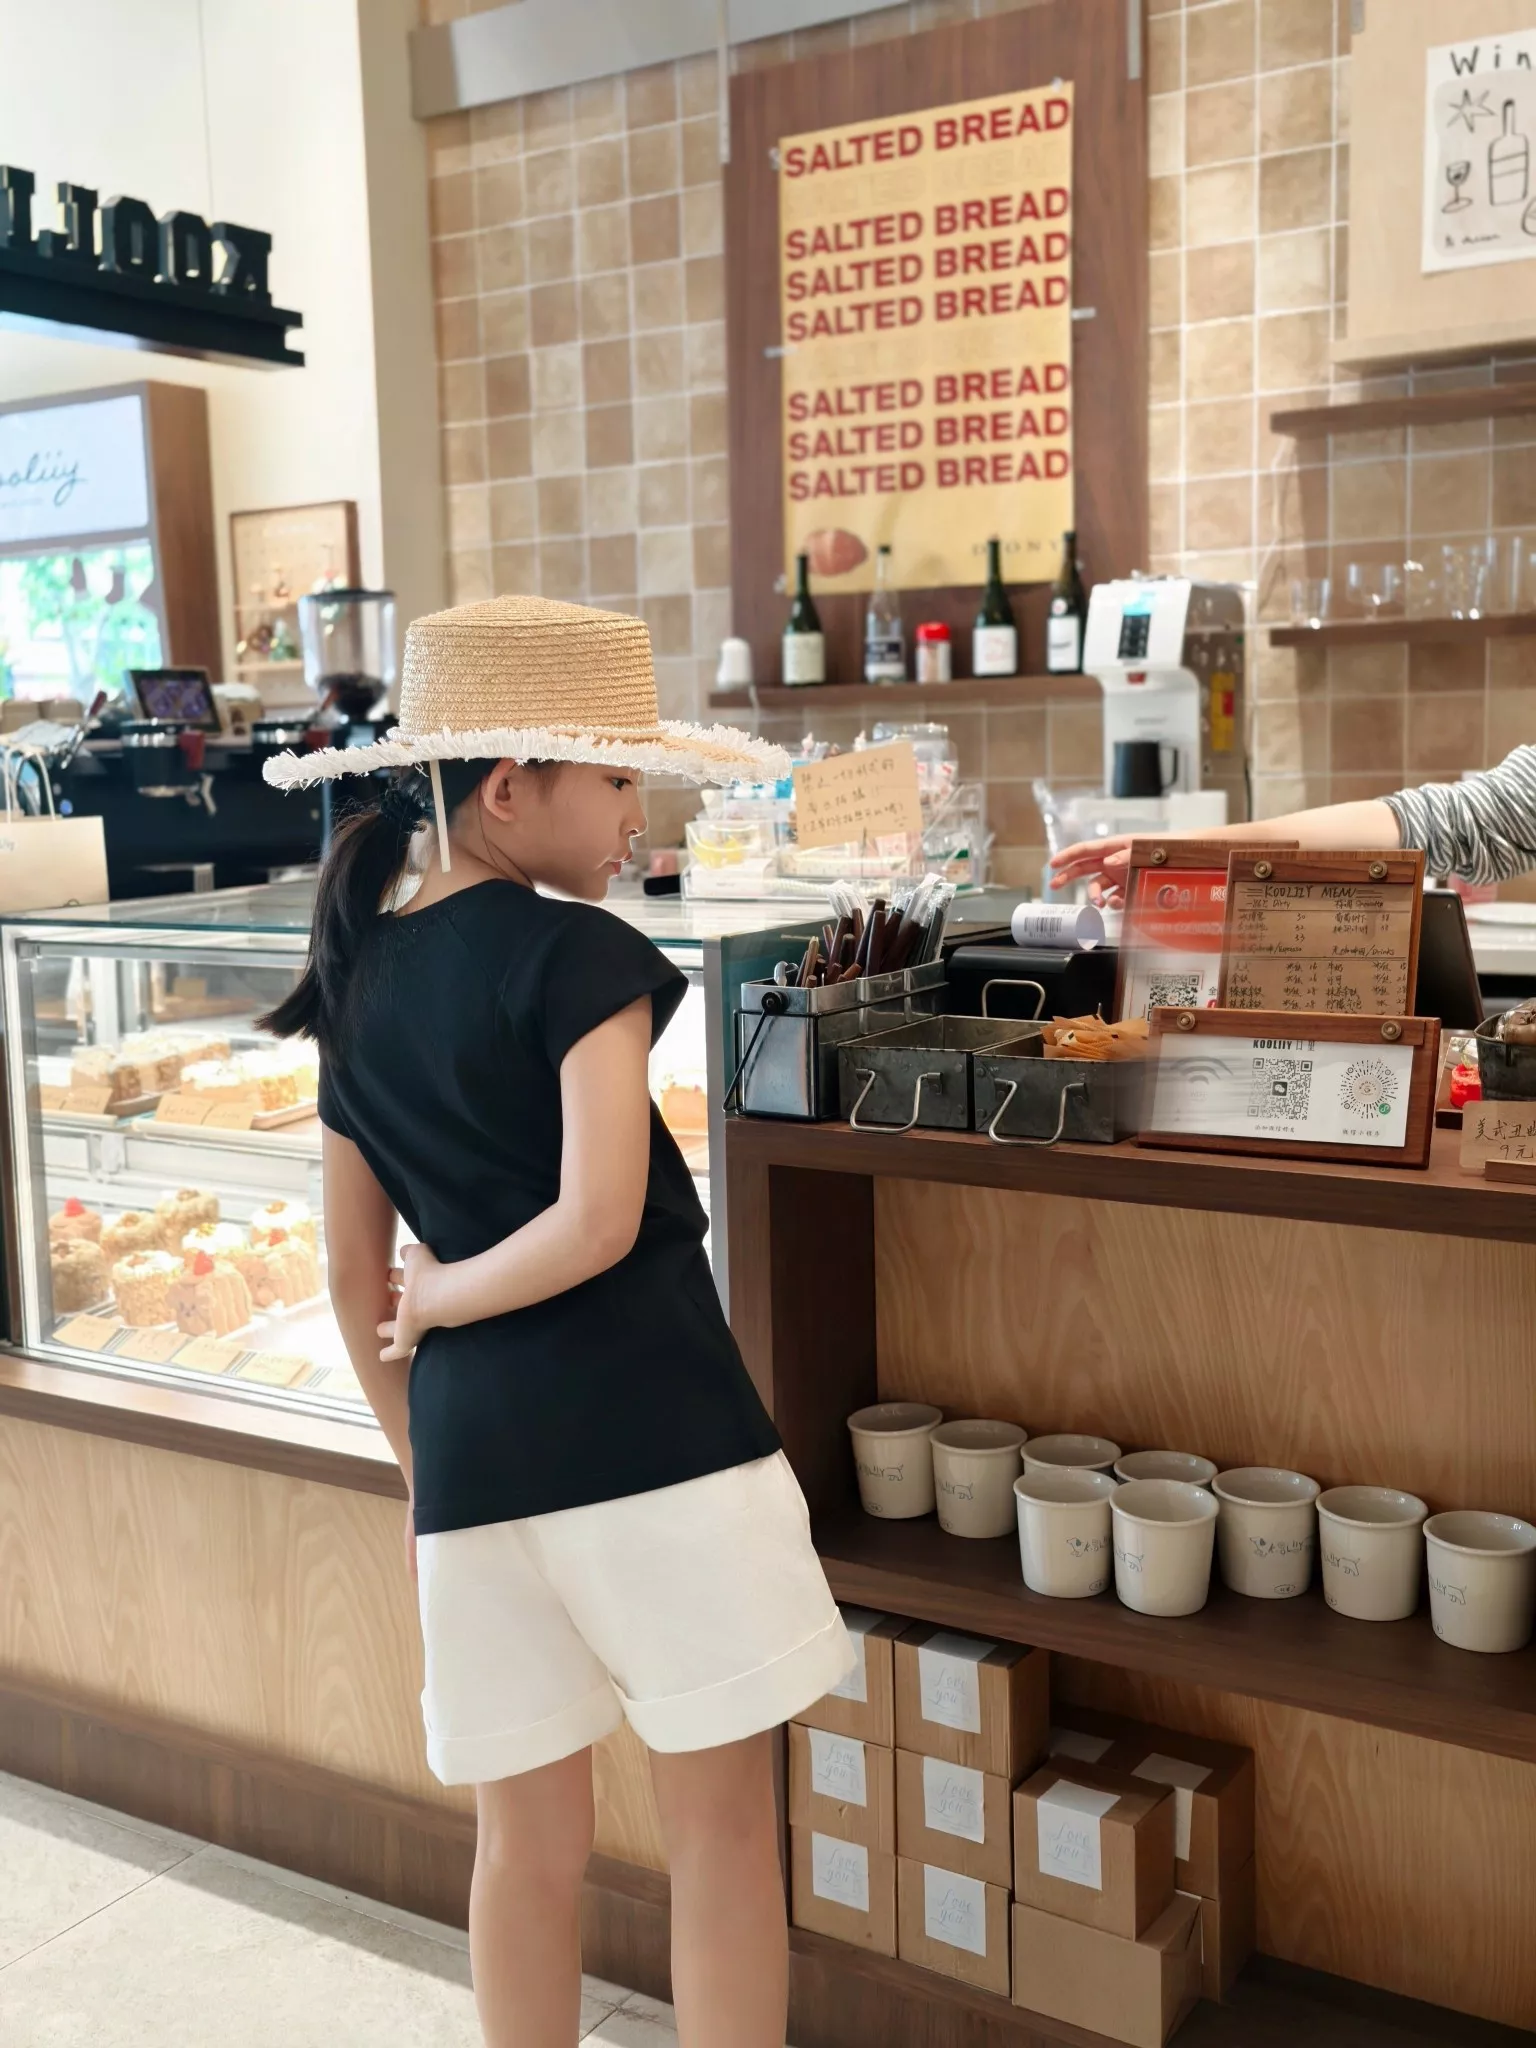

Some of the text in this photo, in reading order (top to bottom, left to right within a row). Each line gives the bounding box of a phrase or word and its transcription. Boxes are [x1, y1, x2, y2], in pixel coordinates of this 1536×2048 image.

[1449, 45, 1532, 77] Win
[785, 98, 1070, 179] SALTED BREAD
[786, 187, 1070, 261] SALTED BREAD
[786, 231, 1070, 302] SALTED BREAD
[787, 275, 1069, 343] SALTED BREAD
[788, 363, 1069, 422] SALTED BREAD
[788, 406, 1070, 462] SALTED BREAD
[0, 449, 88, 508] oliiy
[789, 449, 1070, 503] SALTED BREAD
[1320, 886, 1357, 898] MENU
[1252, 1039, 1293, 1050] KOOLIIY
